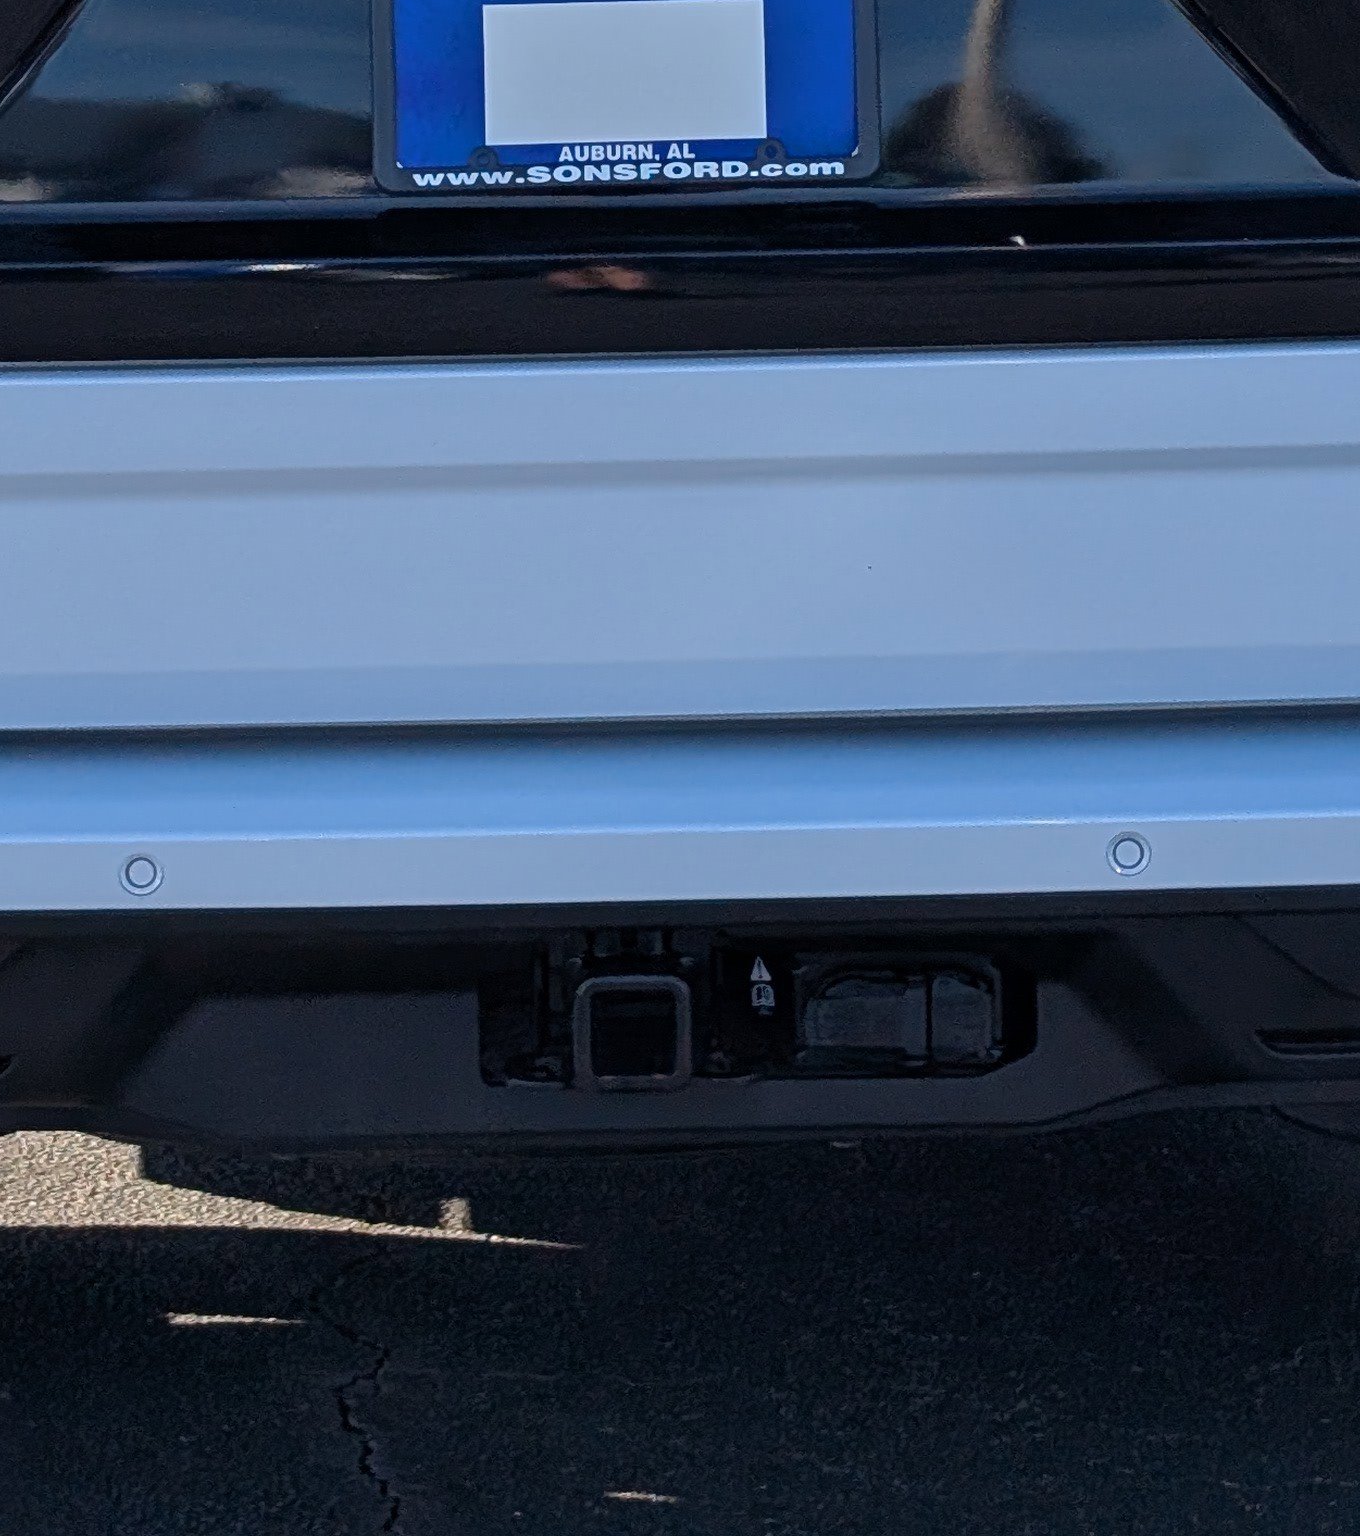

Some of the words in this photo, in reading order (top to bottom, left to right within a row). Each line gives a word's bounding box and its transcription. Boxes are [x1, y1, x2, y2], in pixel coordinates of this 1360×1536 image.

[558, 143, 660, 162] AUBURN,
[666, 142, 696, 160] AL
[412, 161, 845, 187] www.SONSFORD.com
